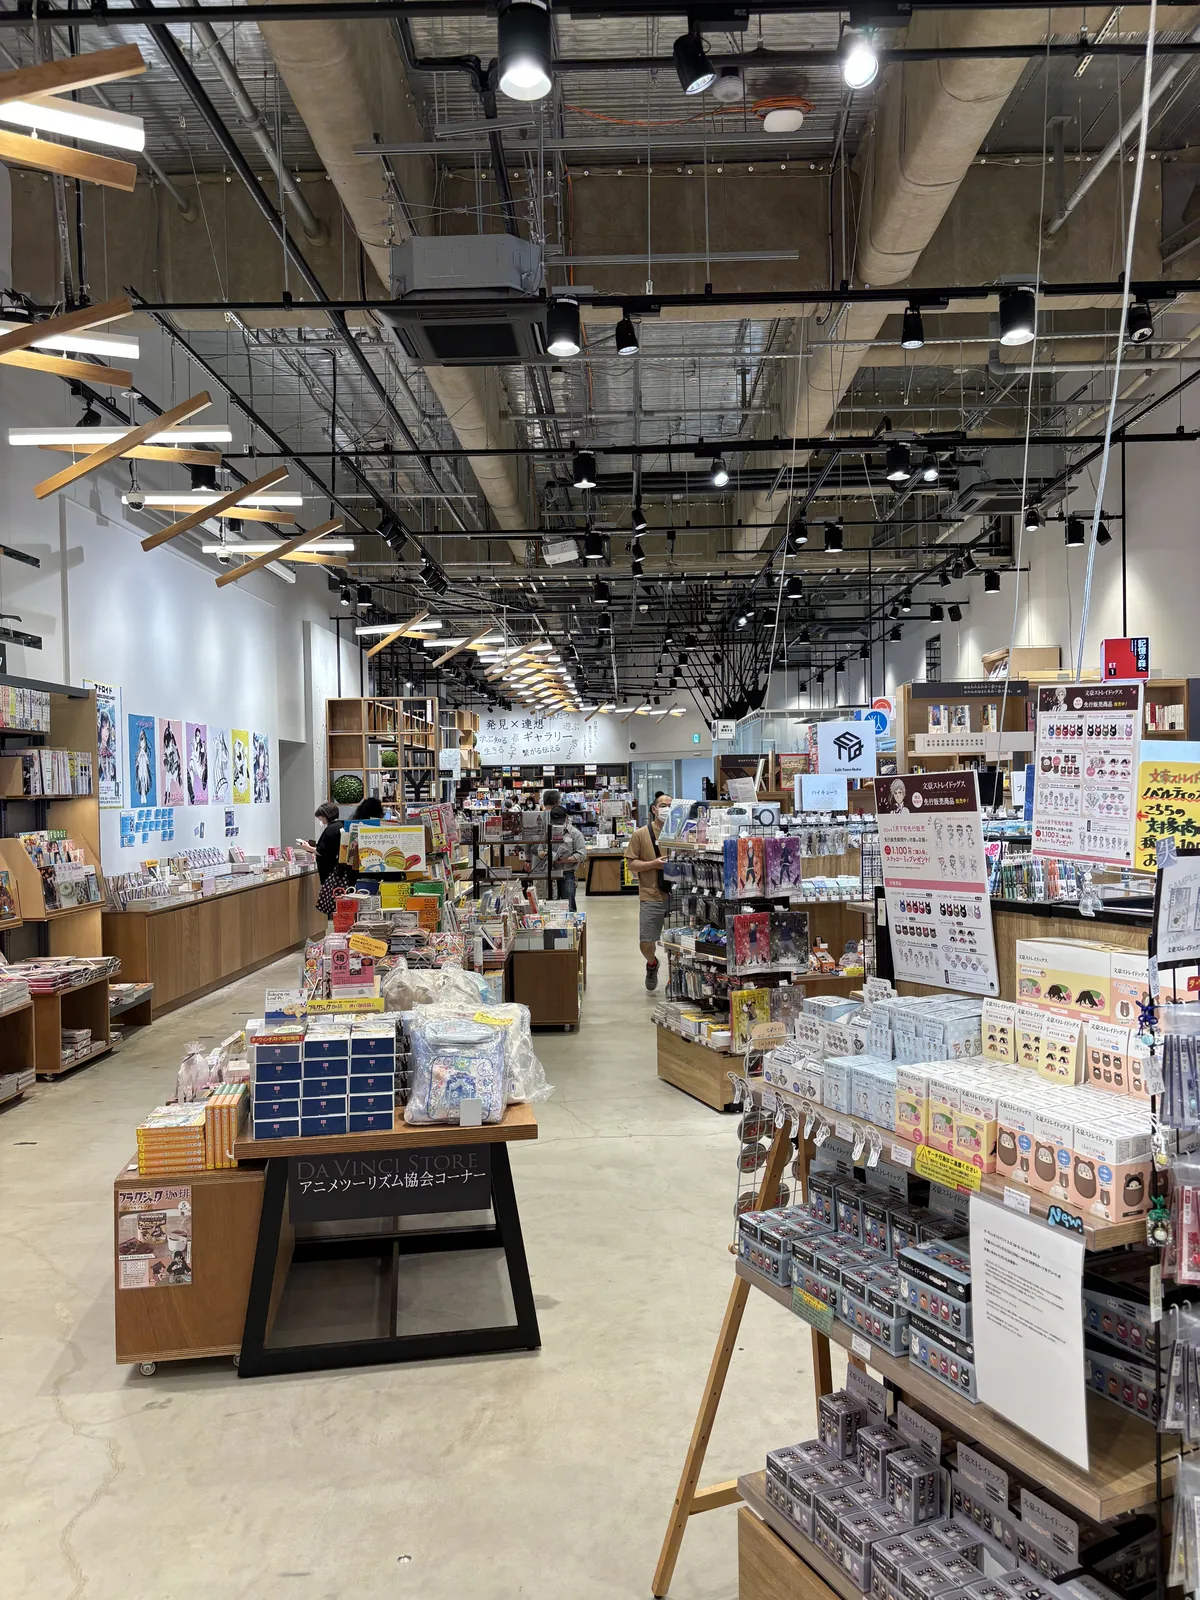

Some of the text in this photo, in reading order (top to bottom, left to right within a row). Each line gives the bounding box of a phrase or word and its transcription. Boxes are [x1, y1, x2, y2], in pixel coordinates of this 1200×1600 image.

[1138, 639, 1147, 671] 記憶の森へ
[523, 731, 573, 742] ギャラリー
[922, 780, 966, 790] 文豪ストレイドッグス
[923, 797, 955, 806] 先行販売商品
[1144, 804, 1186, 818] こちらの
[296, 1152, 477, 1180] DA VINCI STORE
[300, 1169, 486, 1195] アニメツーリズム協会コーナー
